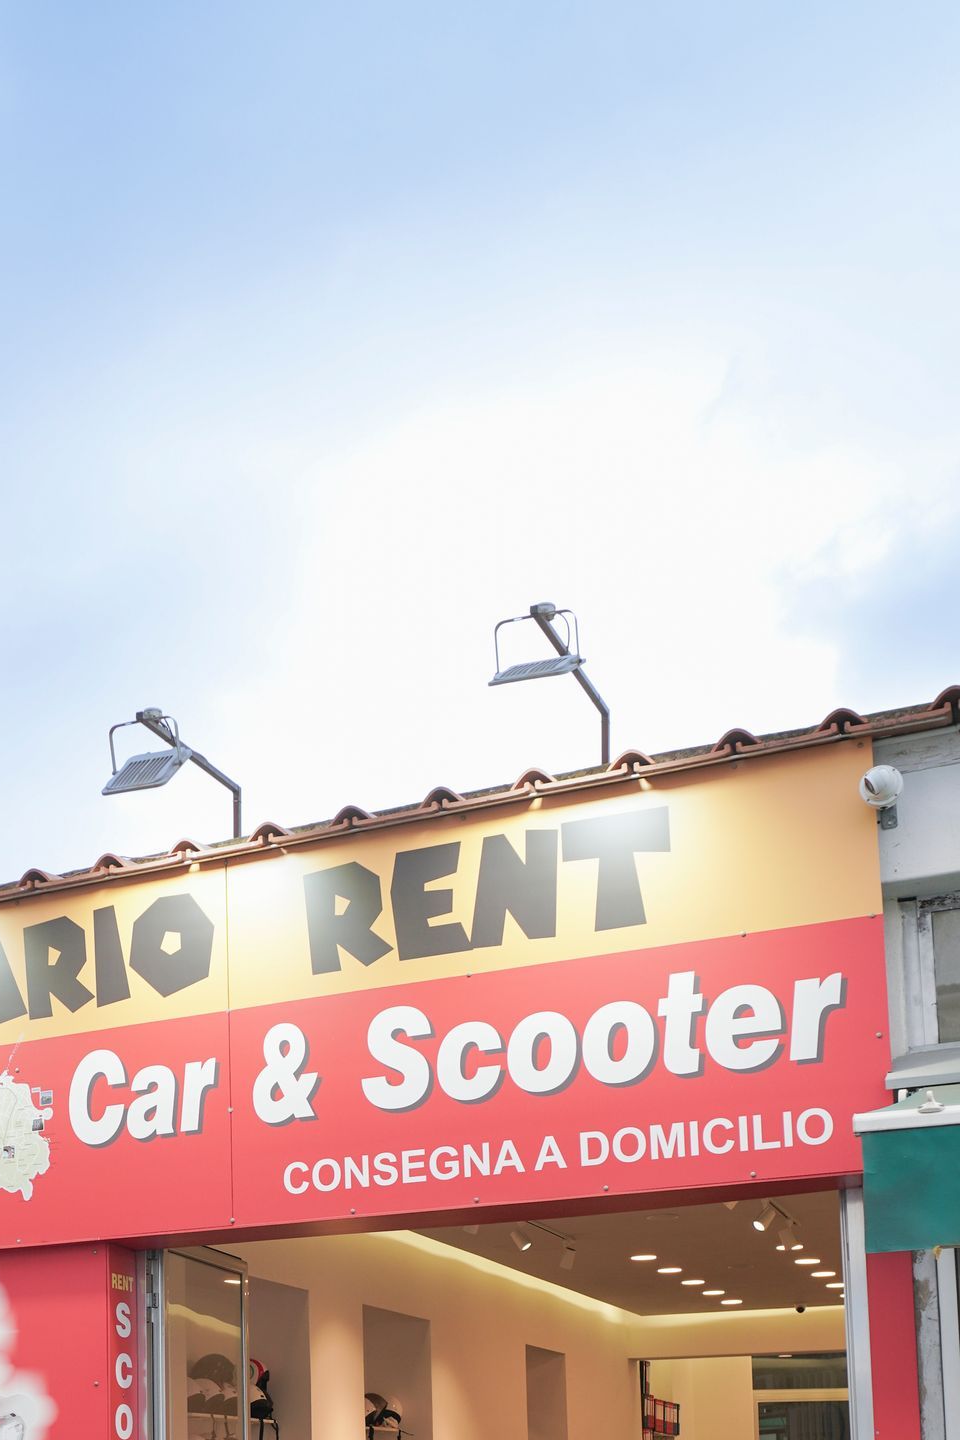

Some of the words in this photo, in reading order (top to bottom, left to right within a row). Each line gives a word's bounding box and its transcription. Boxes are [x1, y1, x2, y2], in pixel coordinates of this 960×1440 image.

[304, 806, 672, 976] RENT
[68, 1048, 220, 1147] Car
[252, 1022, 321, 1125] &
[362, 970, 846, 1113] Scooter
[282, 1141, 526, 1195] CONSEGNA
[535, 1134, 567, 1171] A
[581, 1107, 835, 1166] DOMICILIO
[111, 1272, 134, 1293] RENT
